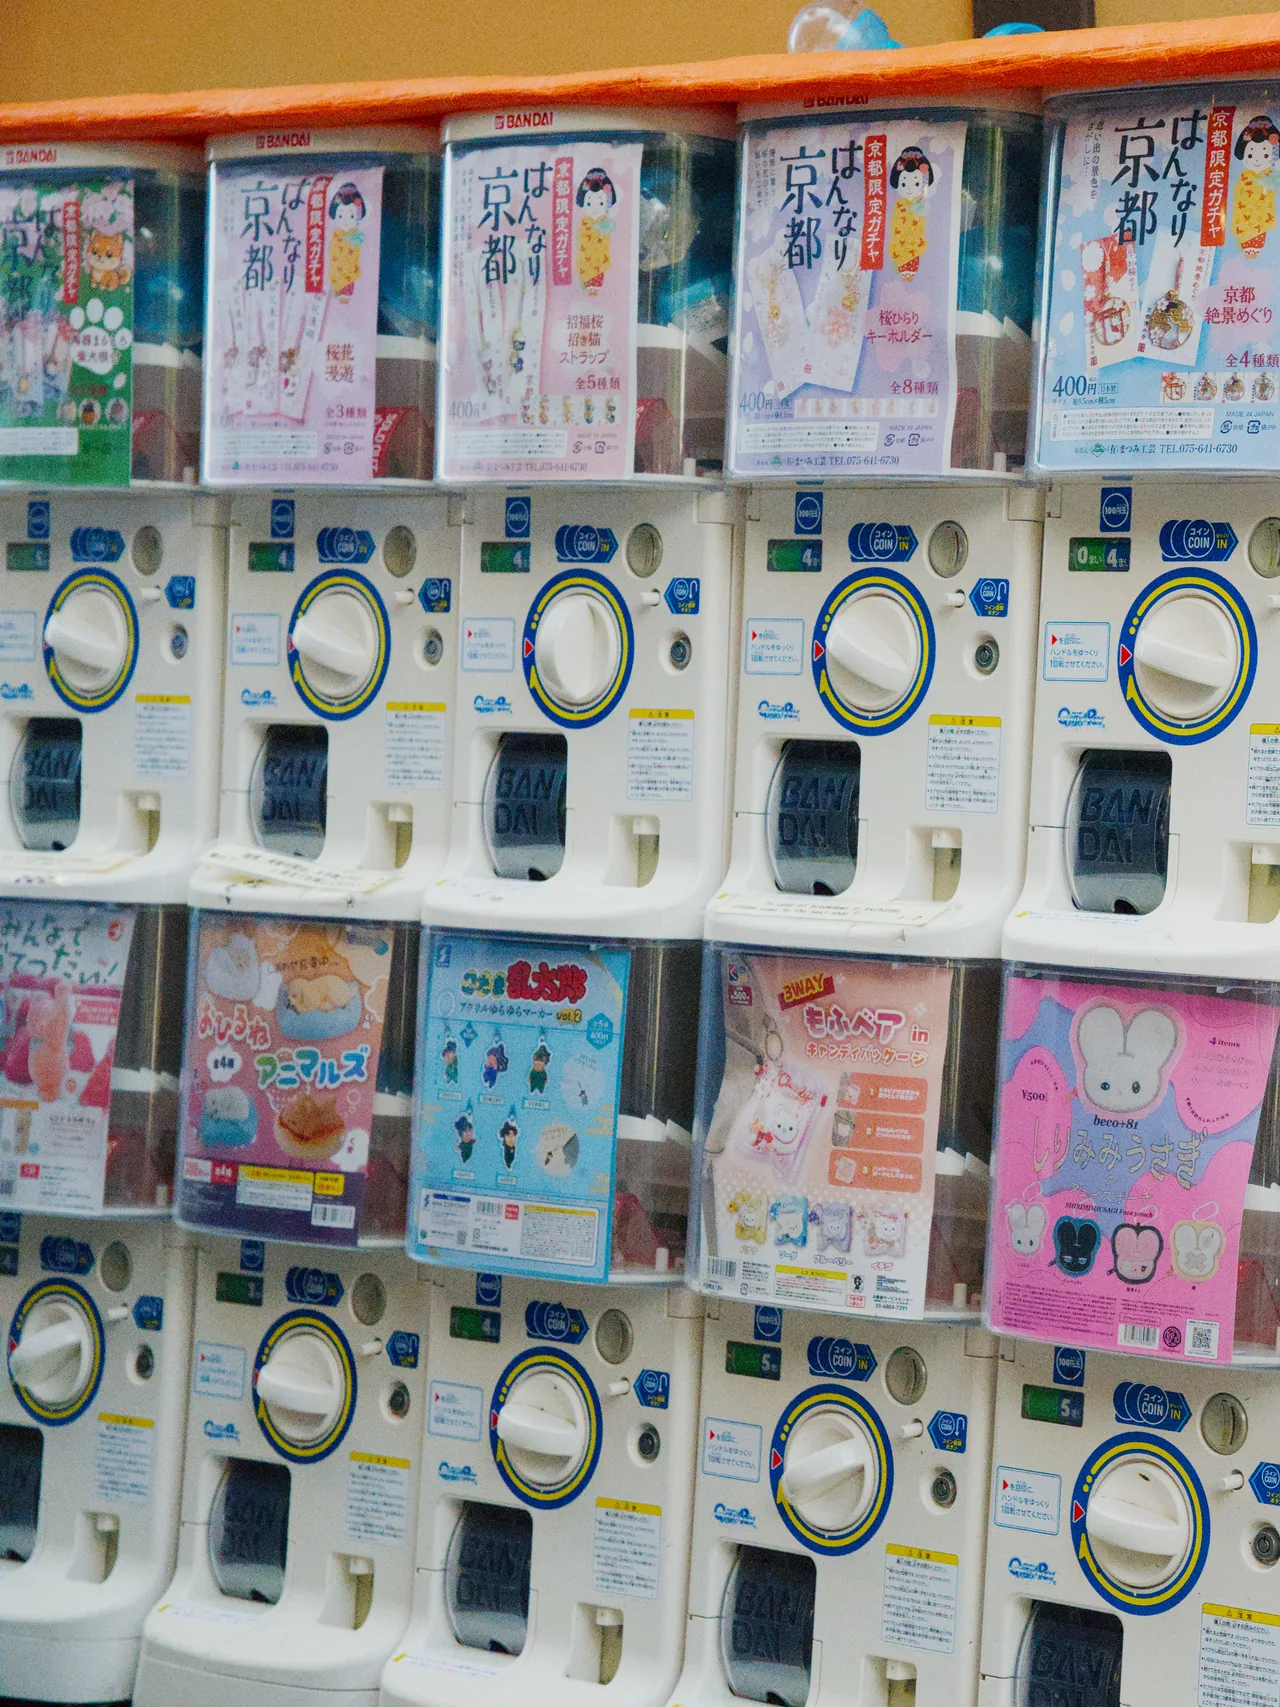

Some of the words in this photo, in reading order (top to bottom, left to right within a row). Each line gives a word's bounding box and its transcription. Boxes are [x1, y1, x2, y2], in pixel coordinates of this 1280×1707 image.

[506, 111, 554, 128] BANDAI
[266, 133, 311, 149] BANDAI
[1111, 115, 1166, 247] 京都
[1162, 109, 1208, 249] はんなり
[1206, 110, 1231, 239] 京都限定ガチャ
[780, 145, 827, 271] 京都
[825, 140, 864, 272] はんなり
[866, 138, 885, 264] 京都限定ガチャ
[478, 166, 519, 285] 京都
[518, 162, 553, 287] はんなり
[554, 160, 572, 279] 京都限定ガチャ
[241, 180, 279, 291] 京都
[277, 178, 309, 294] はんなり
[1223, 286, 1256, 304] 京都
[566, 313, 604, 330] 招福桜
[878, 309, 920, 326] 桜ひらり
[1205, 307, 1274, 325] 絶景めぐり
[566, 332, 602, 348] 招き猫
[866, 330, 933, 344] キーホルダー
[559, 350, 610, 365] ストラップ
[1224, 351, 1280, 369] 全4種類
[575, 374, 621, 391] 全5種類
[889, 379, 940, 396] 全8種類
[1052, 375, 1098, 398] 400円
[739, 391, 774, 411] 400円
[325, 404, 367, 420] 全3種類
[1160, 444, 1238, 455] TEL.075-641-6730
[1104, 504, 1127, 517] 100円玉
[1187, 535, 1211, 550] COIN
[783, 973, 826, 1002] 3WAY
[459, 1002, 554, 1019] アクリルゆらゆらマーカー
[198, 1001, 273, 1049] おひるね
[804, 1003, 906, 1044] もふベア
[911, 1025, 930, 1044] in
[1218, 1039, 1241, 1048] items
[806, 1042, 929, 1067] キャンディパッケージ
[255, 1045, 371, 1090] アニマルズ
[1021, 1089, 1046, 1102] ¥500
[1032, 1116, 1208, 1190] しりみみうさぎ
[813, 1254, 853, 1267] ブルーベリー
[871, 1262, 894, 1271] イチゴ
[831, 1354, 853, 1369] COIN
[1060, 1397, 1071, 1417] 5
[1141, 1401, 1164, 1417] COIN
